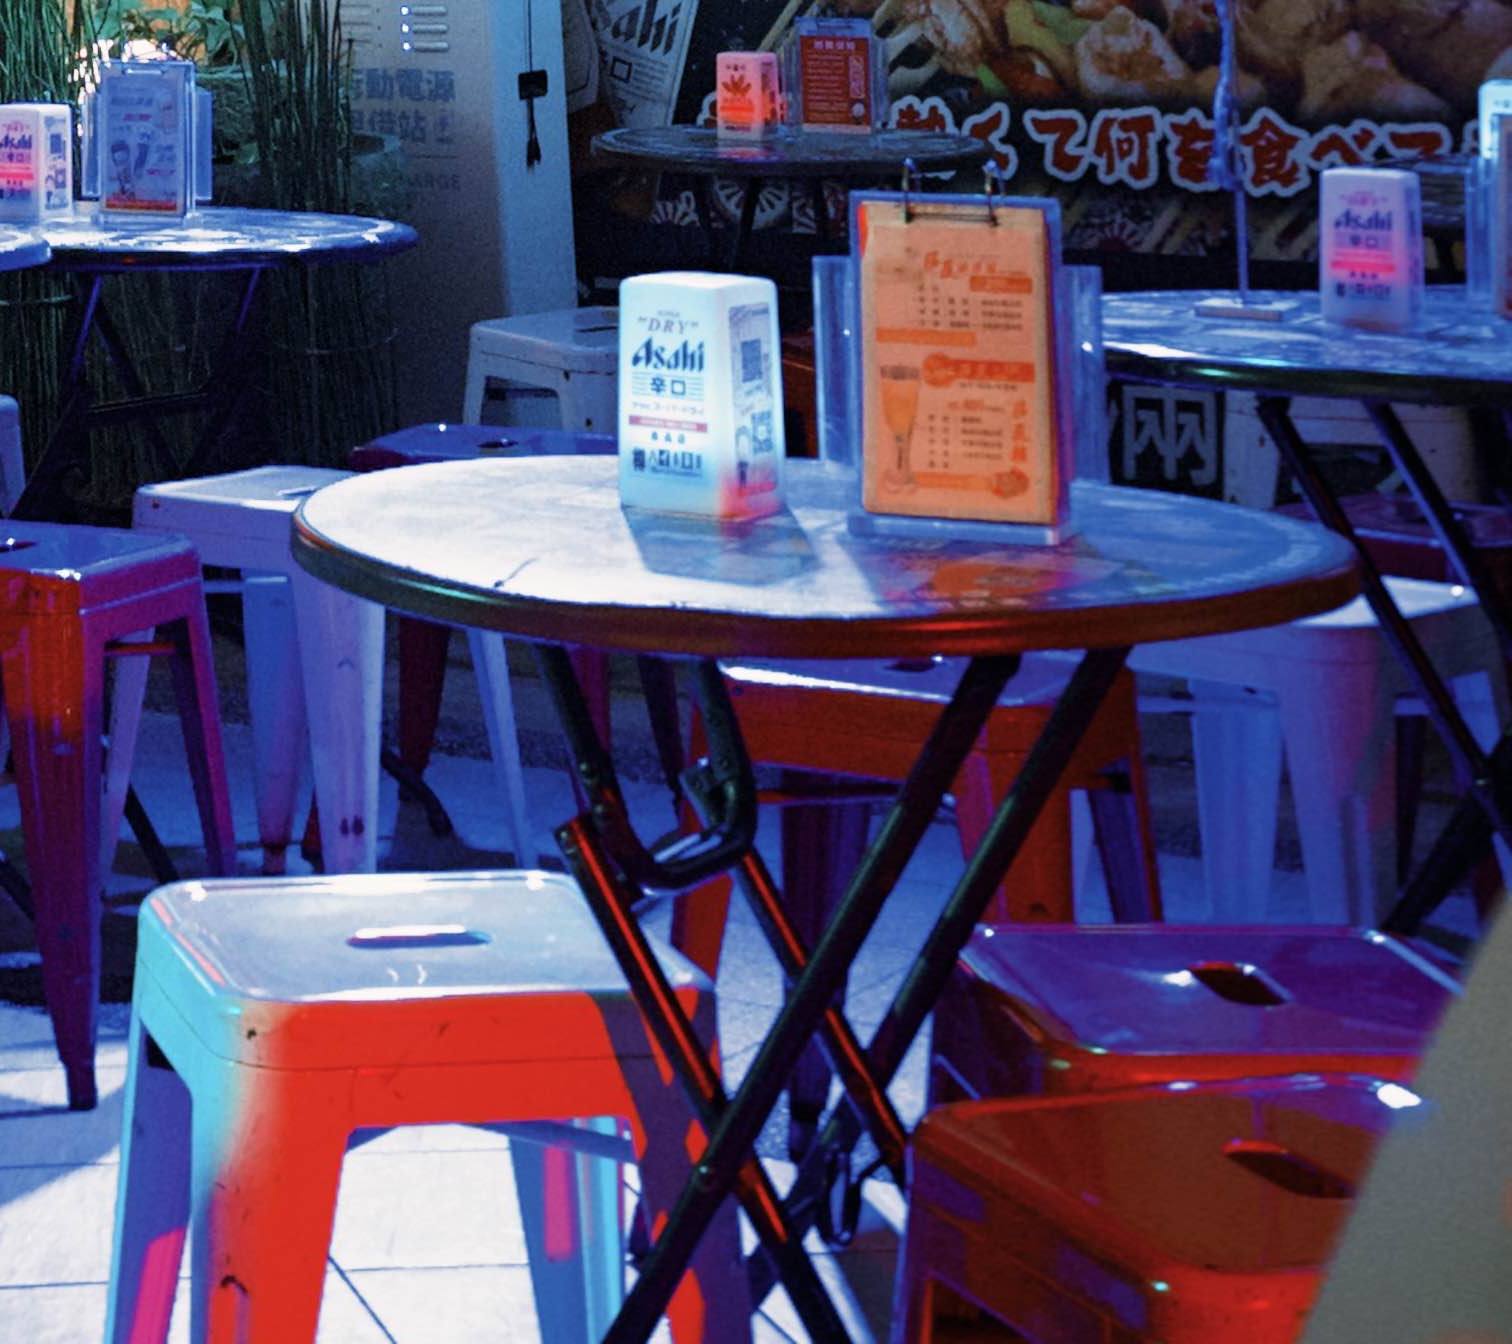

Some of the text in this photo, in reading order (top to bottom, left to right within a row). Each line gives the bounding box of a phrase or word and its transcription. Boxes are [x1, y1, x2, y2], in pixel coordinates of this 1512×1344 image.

[1334, 208, 1392, 231] Asahi
[631, 336, 705, 374] Asahi
[650, 374, 687, 396] 辛口
